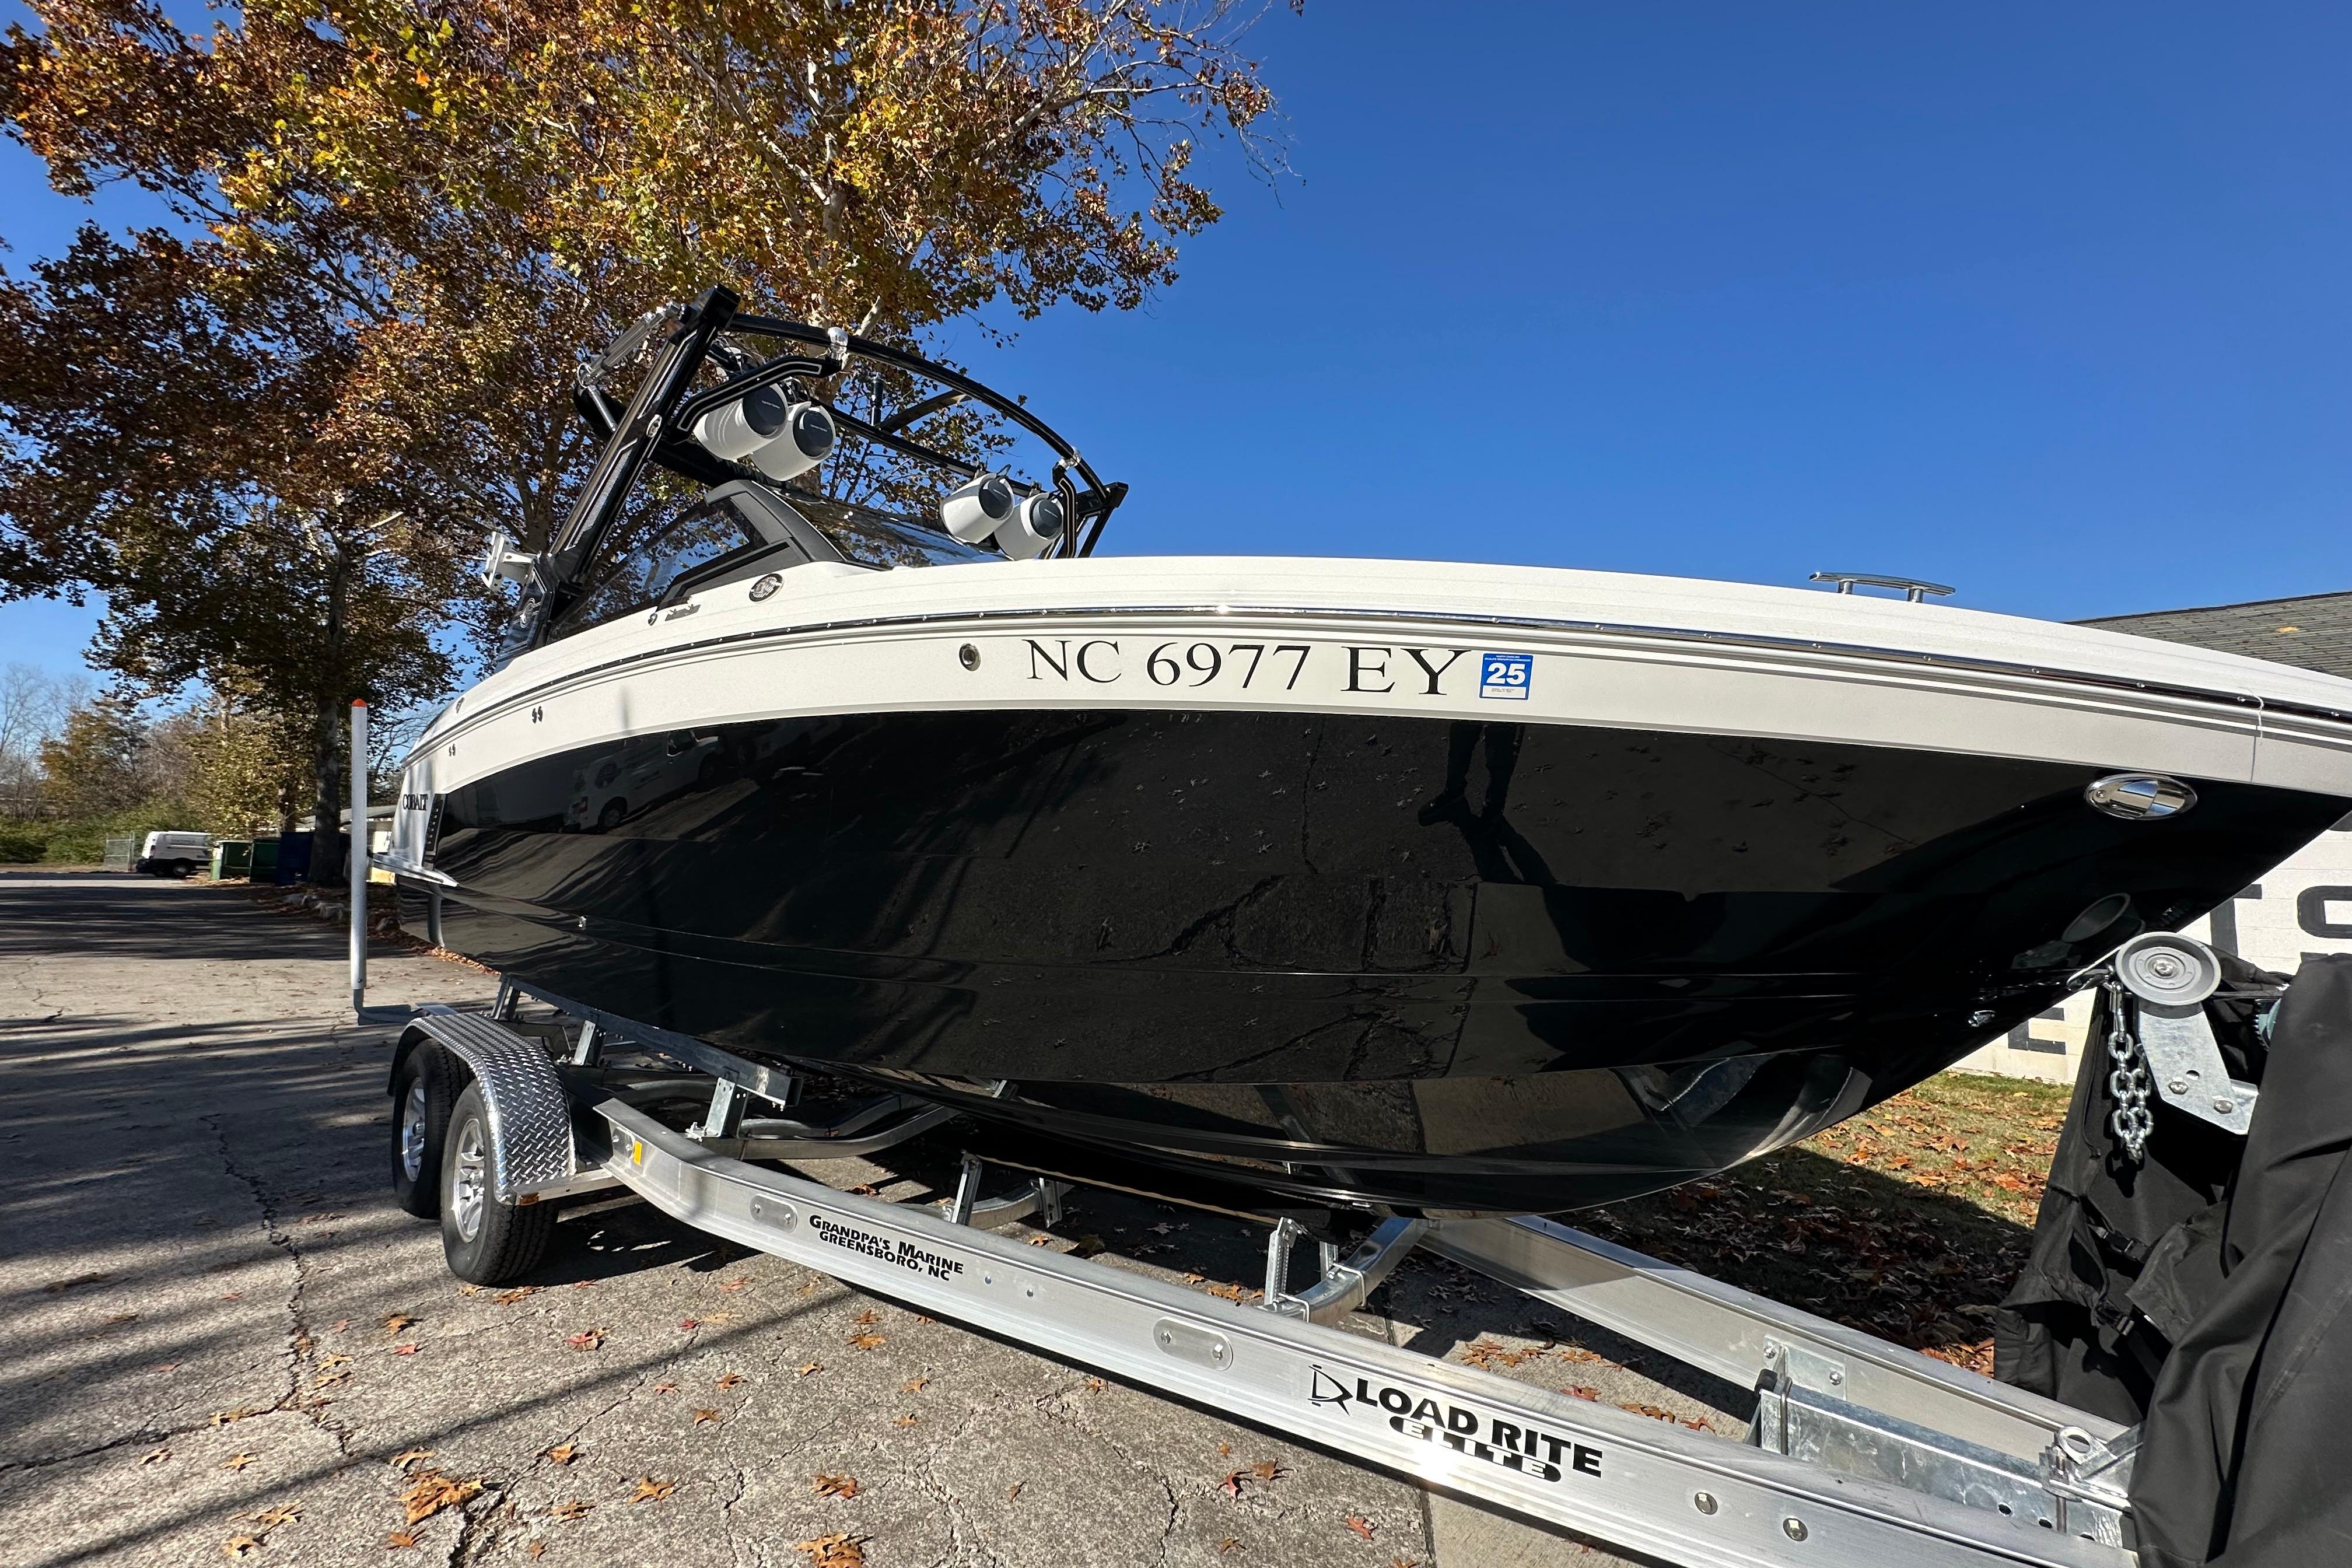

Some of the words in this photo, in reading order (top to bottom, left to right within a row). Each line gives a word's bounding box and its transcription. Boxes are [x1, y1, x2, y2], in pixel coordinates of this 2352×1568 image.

[1022, 639, 1122, 682] NC
[1147, 642, 1311, 691] 6977
[1340, 646, 1471, 696] EY
[1486, 662, 1526, 685] 25
[402, 793, 428, 811] COBALT
[809, 1214, 890, 1250] GRANDPA'S
[898, 1241, 964, 1275] MARINE
[819, 1231, 923, 1272] GREENSBORO,
[928, 1265, 950, 1282] NC
[1356, 1378, 1479, 1435] LOAD
[1491, 1419, 1603, 1478] RITE
[1402, 1418, 1546, 1479] ELITE
